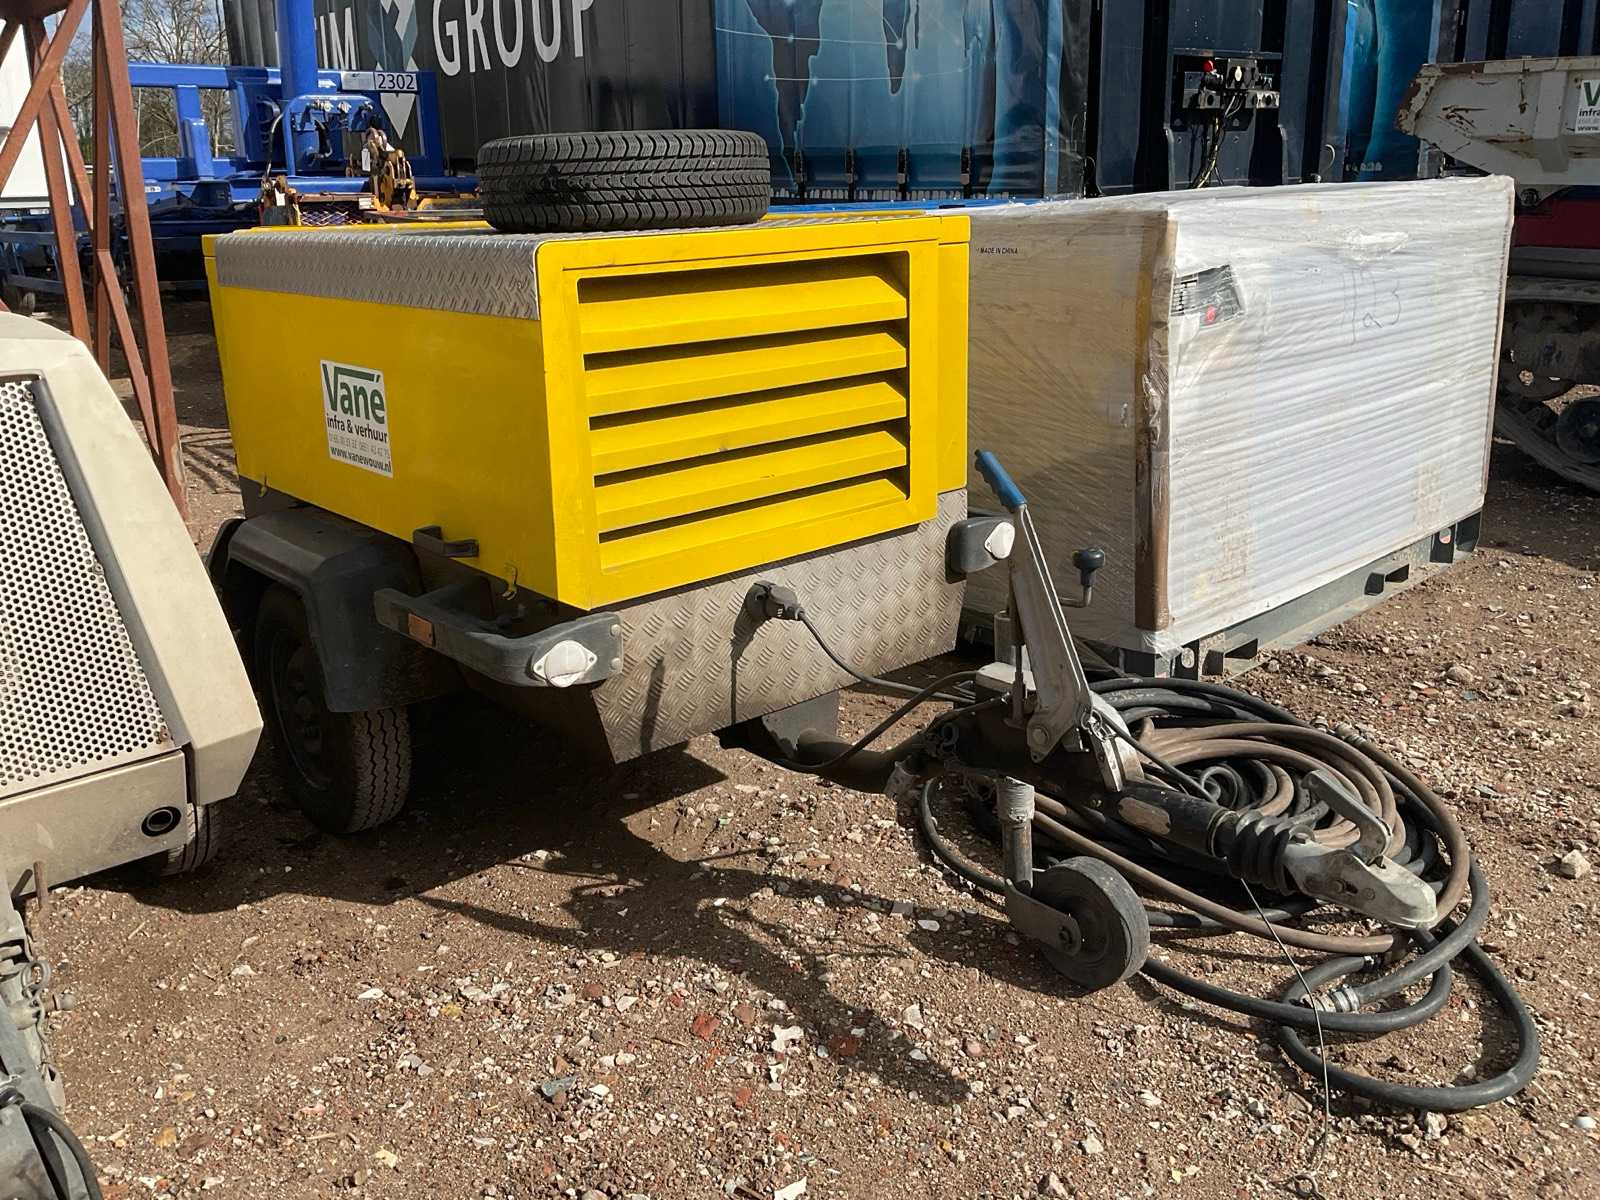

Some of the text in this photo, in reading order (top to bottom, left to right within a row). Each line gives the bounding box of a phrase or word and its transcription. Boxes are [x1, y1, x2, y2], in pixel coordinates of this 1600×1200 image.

[314, 0, 593, 76] IM GROUP
[377, 73, 415, 90] 2302
[980, 247, 995, 255] MADE
[1002, 247, 1018, 255] CHINA
[322, 363, 385, 425] Vané
[327, 413, 388, 443] infra & verhuur
[330, 447, 392, 473] www.vanewouw.nl
